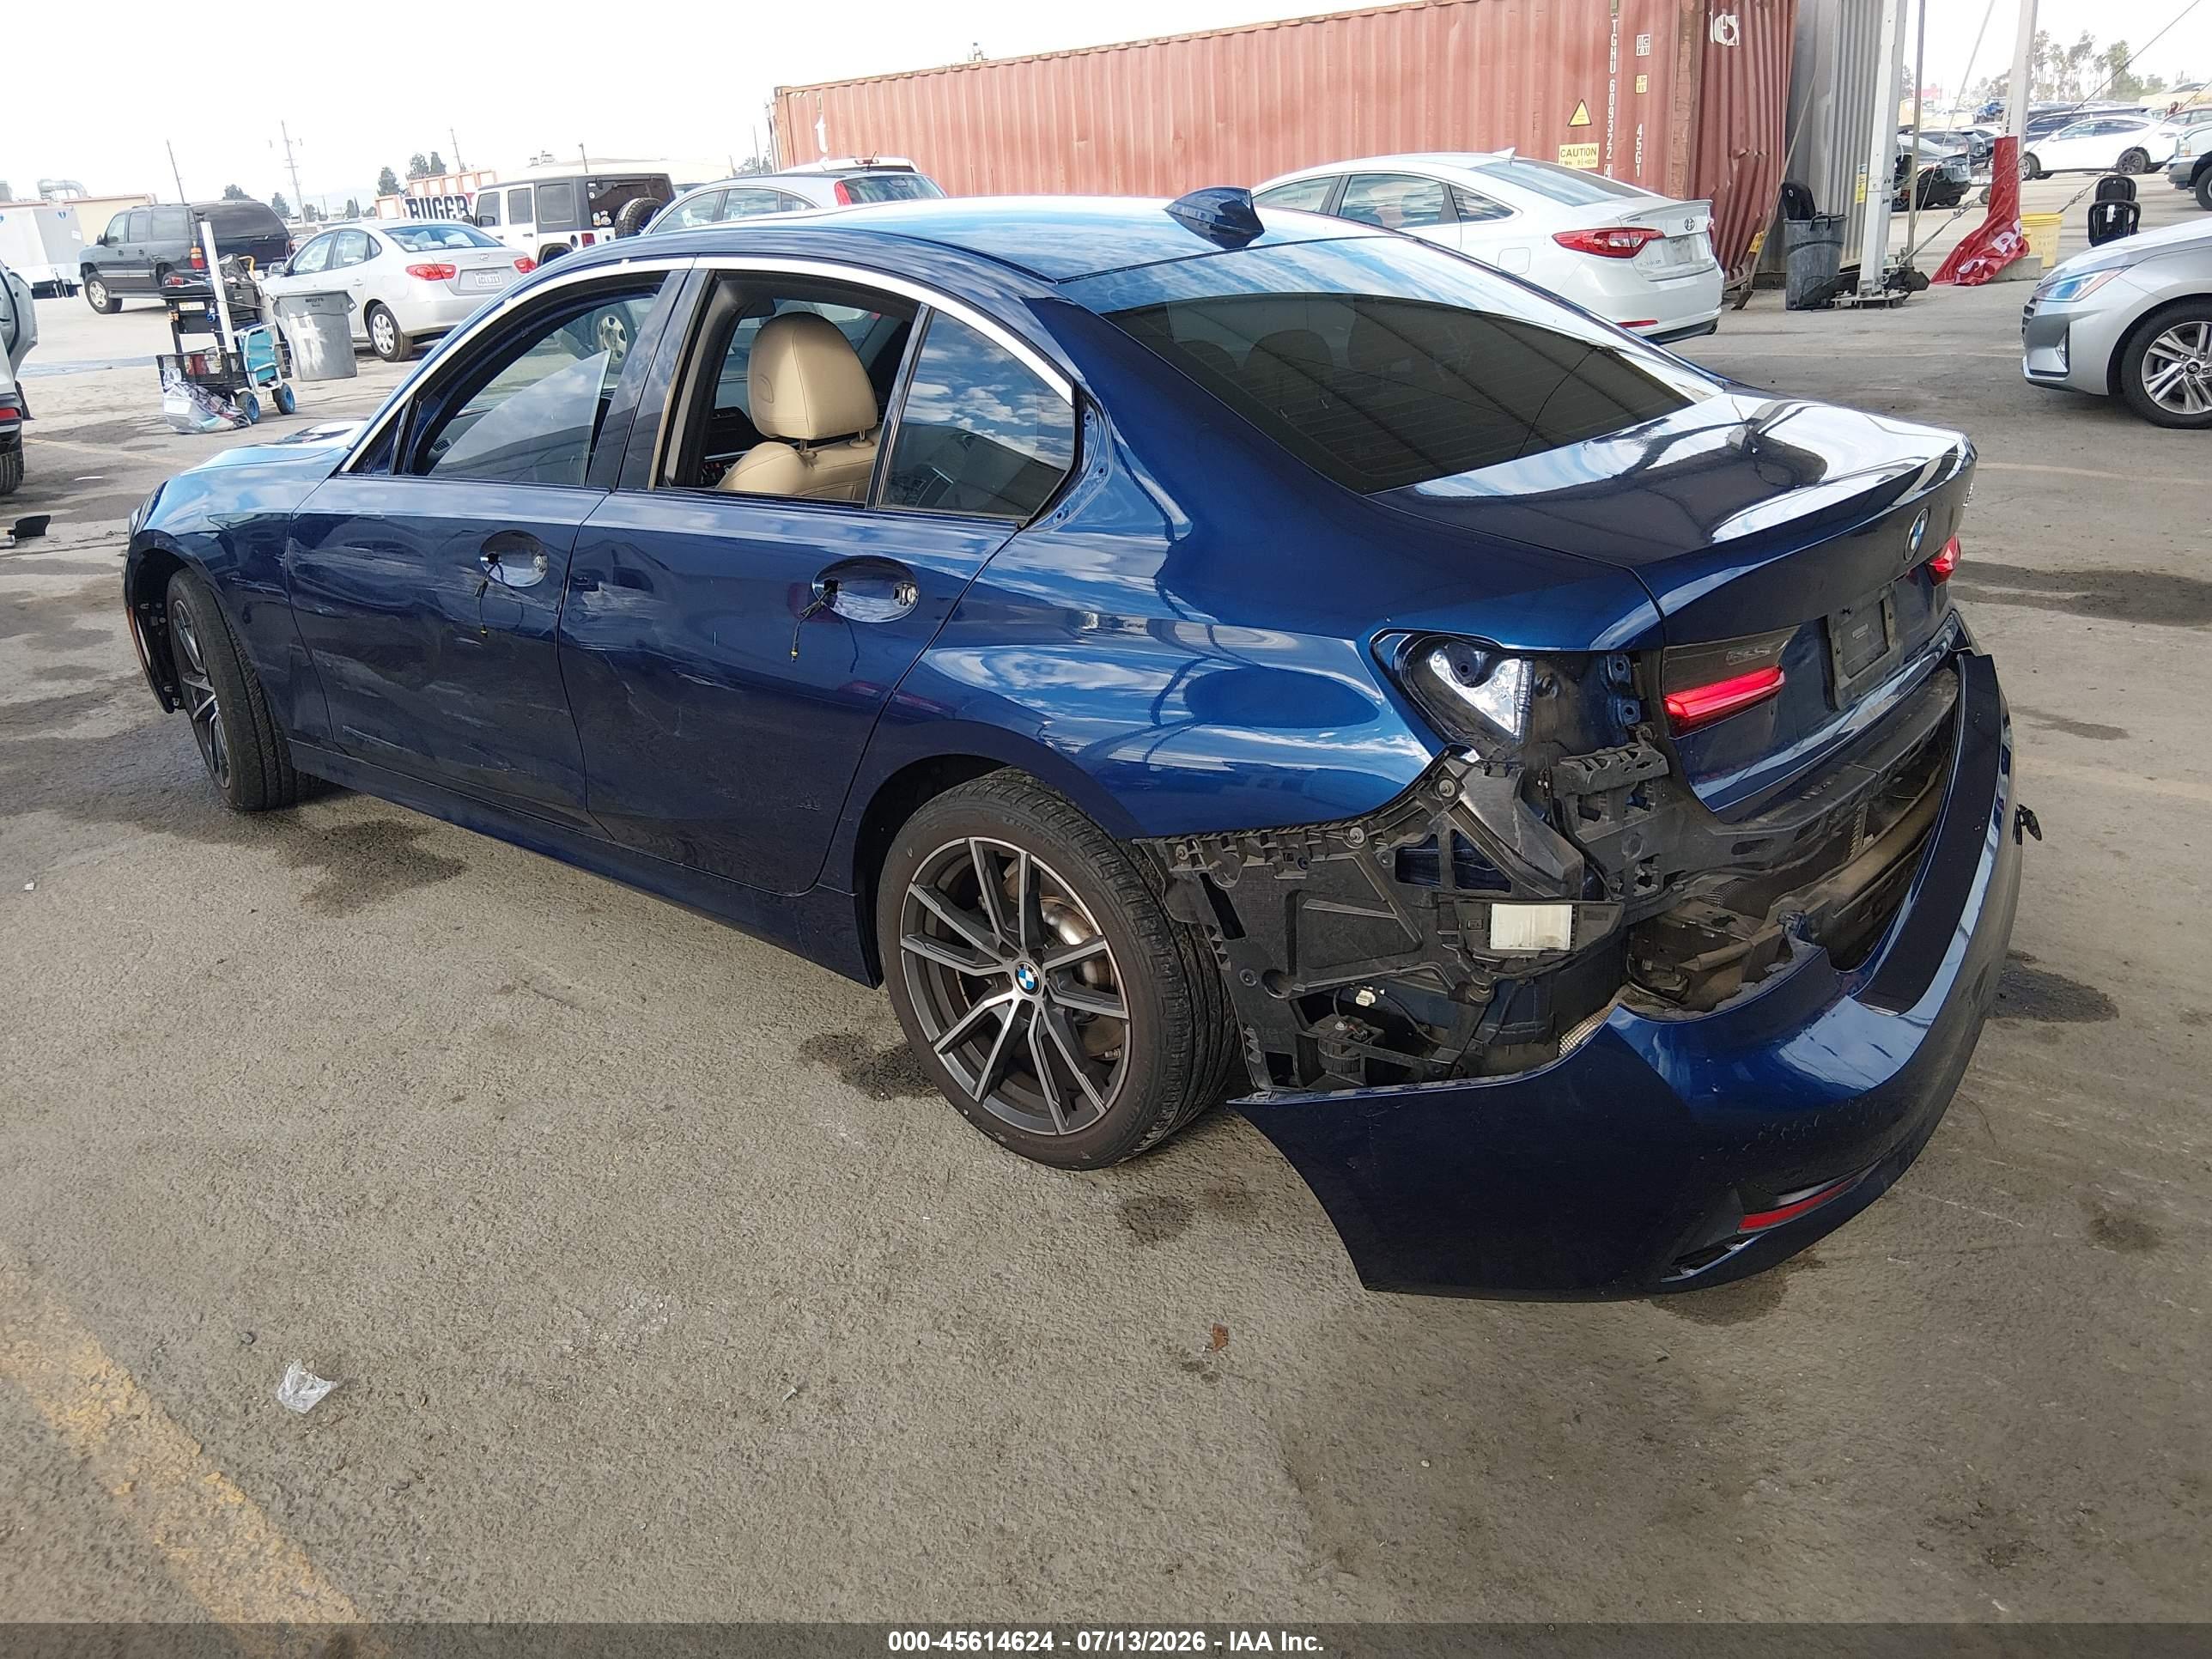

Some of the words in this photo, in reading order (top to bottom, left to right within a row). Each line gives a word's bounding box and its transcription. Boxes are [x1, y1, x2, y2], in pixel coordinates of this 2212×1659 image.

[1609, 19, 1619, 74] TGHU
[1606, 79, 1616, 160] 609322
[1560, 146, 1597, 158] CAUTION
